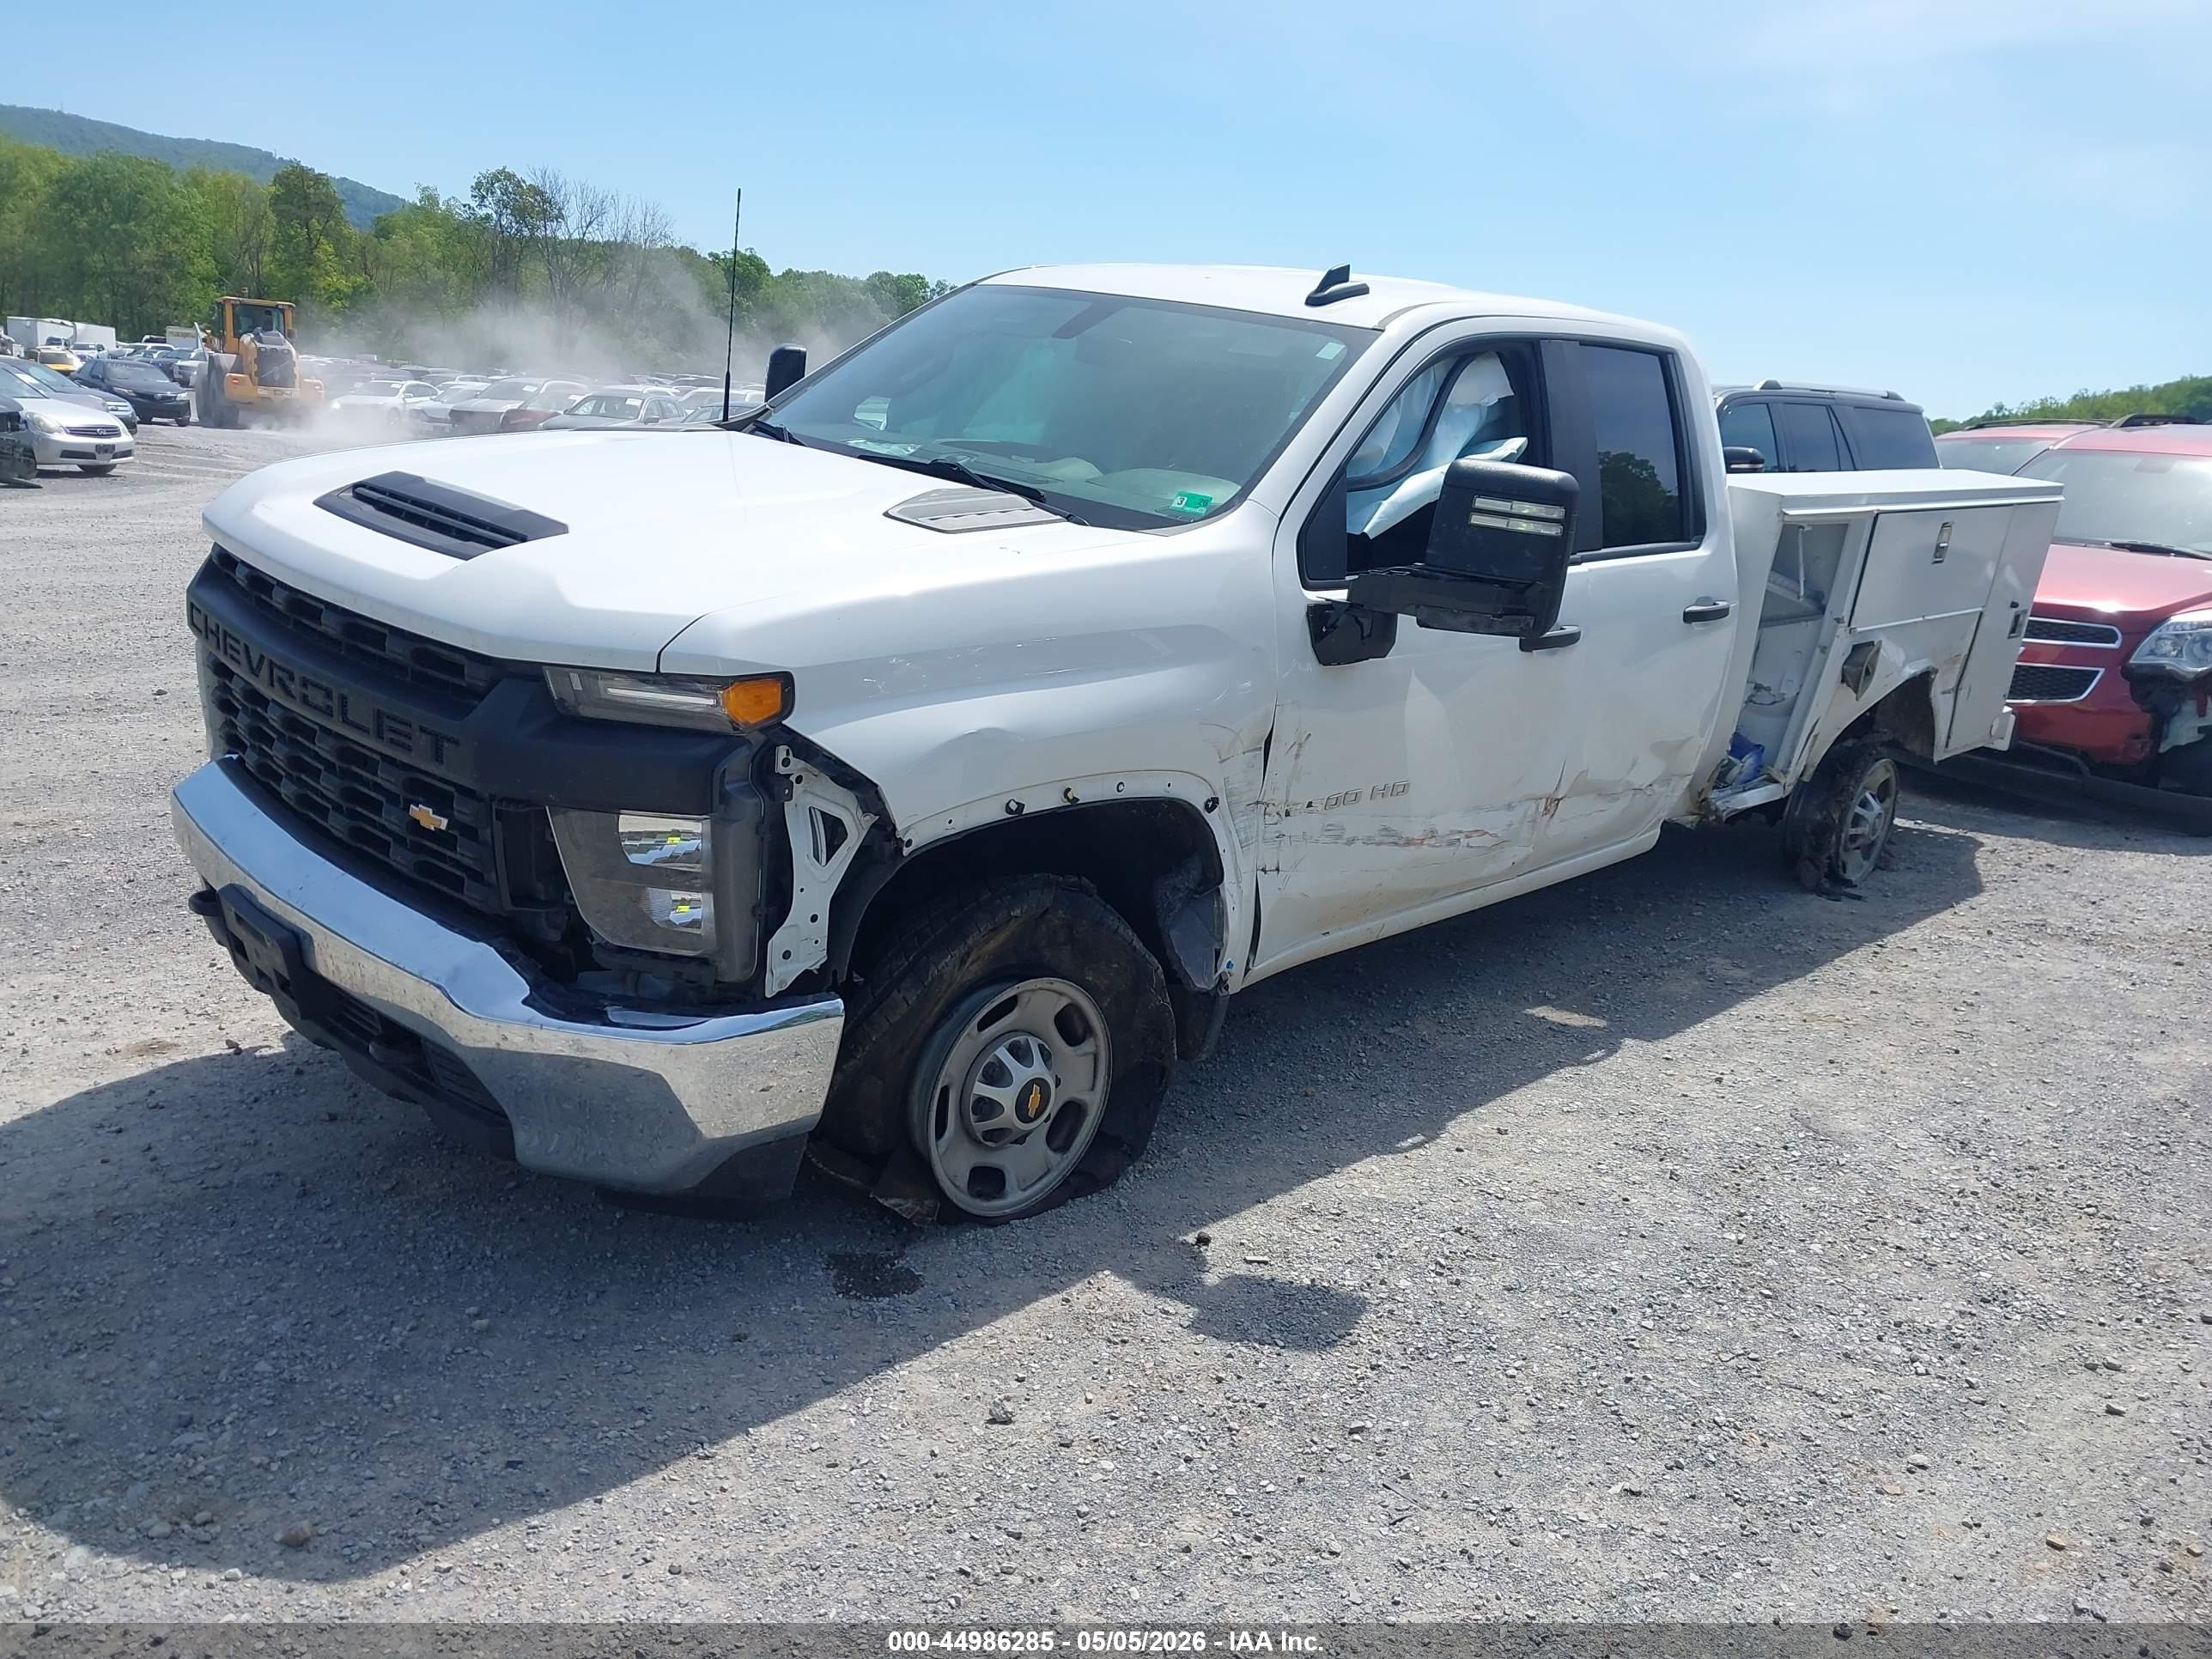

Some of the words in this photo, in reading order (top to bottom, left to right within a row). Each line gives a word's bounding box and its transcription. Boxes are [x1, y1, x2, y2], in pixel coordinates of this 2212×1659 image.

[1176, 497, 1185, 506] 3
[189, 601, 461, 765] CHEVROLET
[1370, 780, 1411, 800] HD
